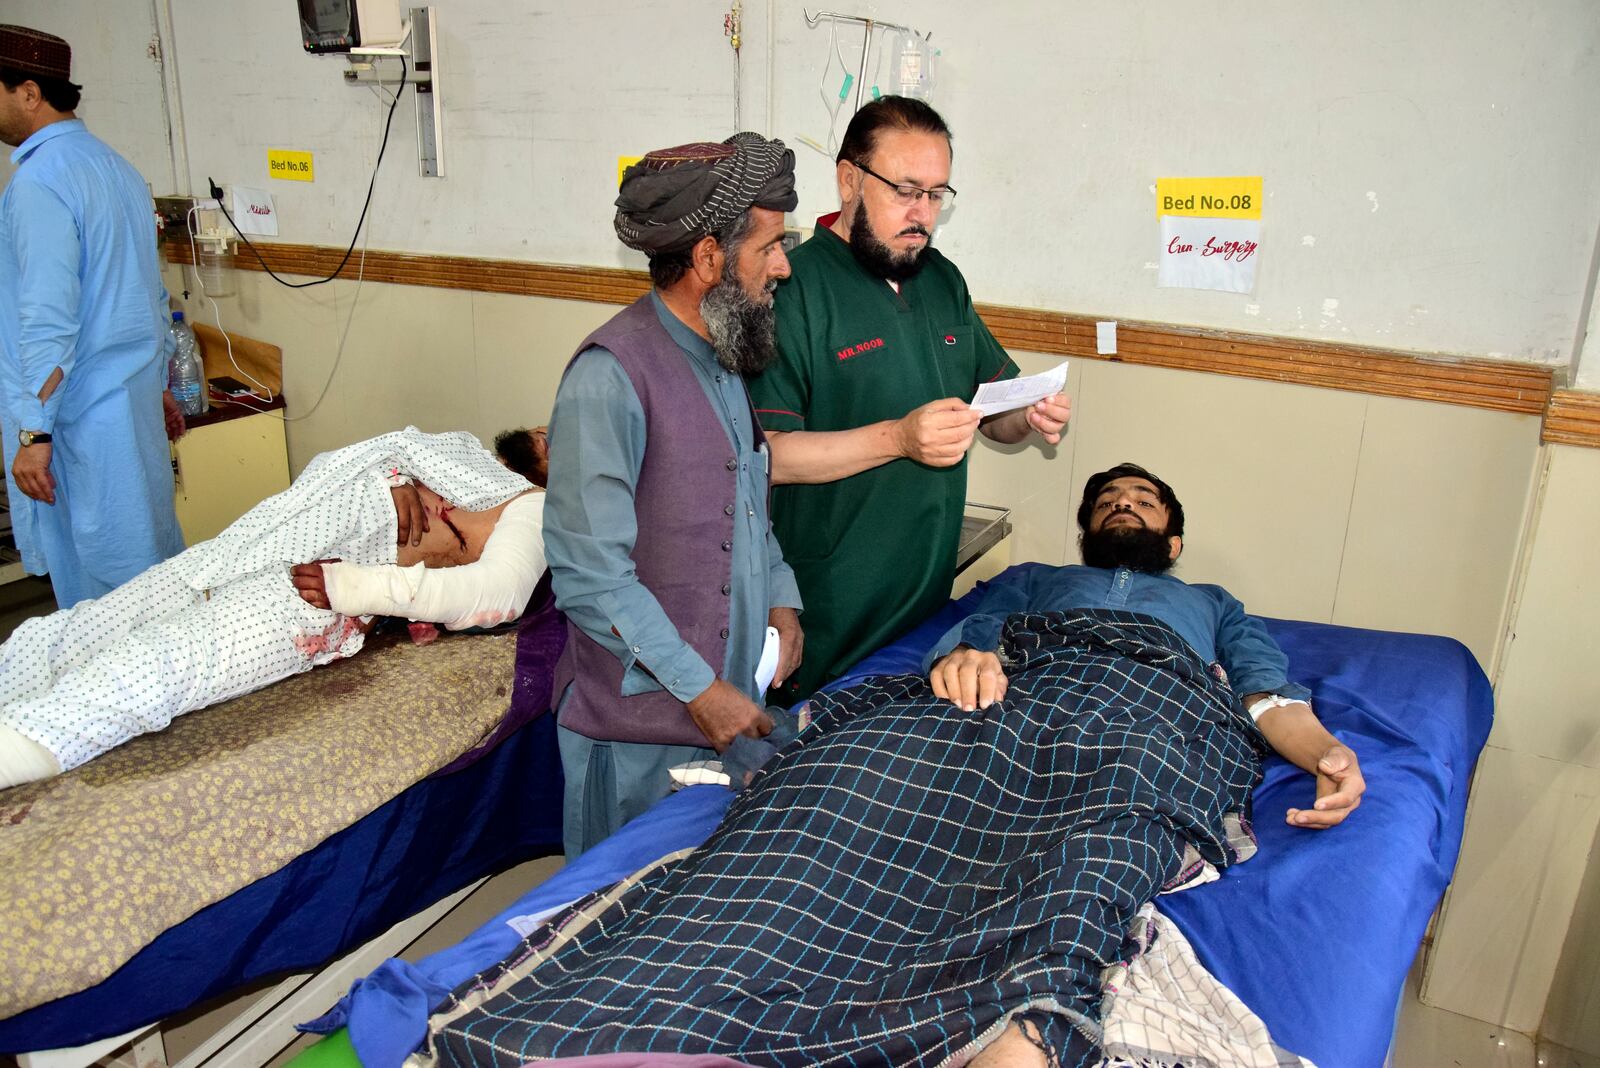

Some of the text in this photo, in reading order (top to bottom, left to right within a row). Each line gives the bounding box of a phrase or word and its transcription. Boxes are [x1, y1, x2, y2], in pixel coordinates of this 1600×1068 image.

[271, 160, 309, 172] Bed No.06
[1163, 195, 1252, 210] Bed No.08
[1201, 236, 1258, 263] Surgery
